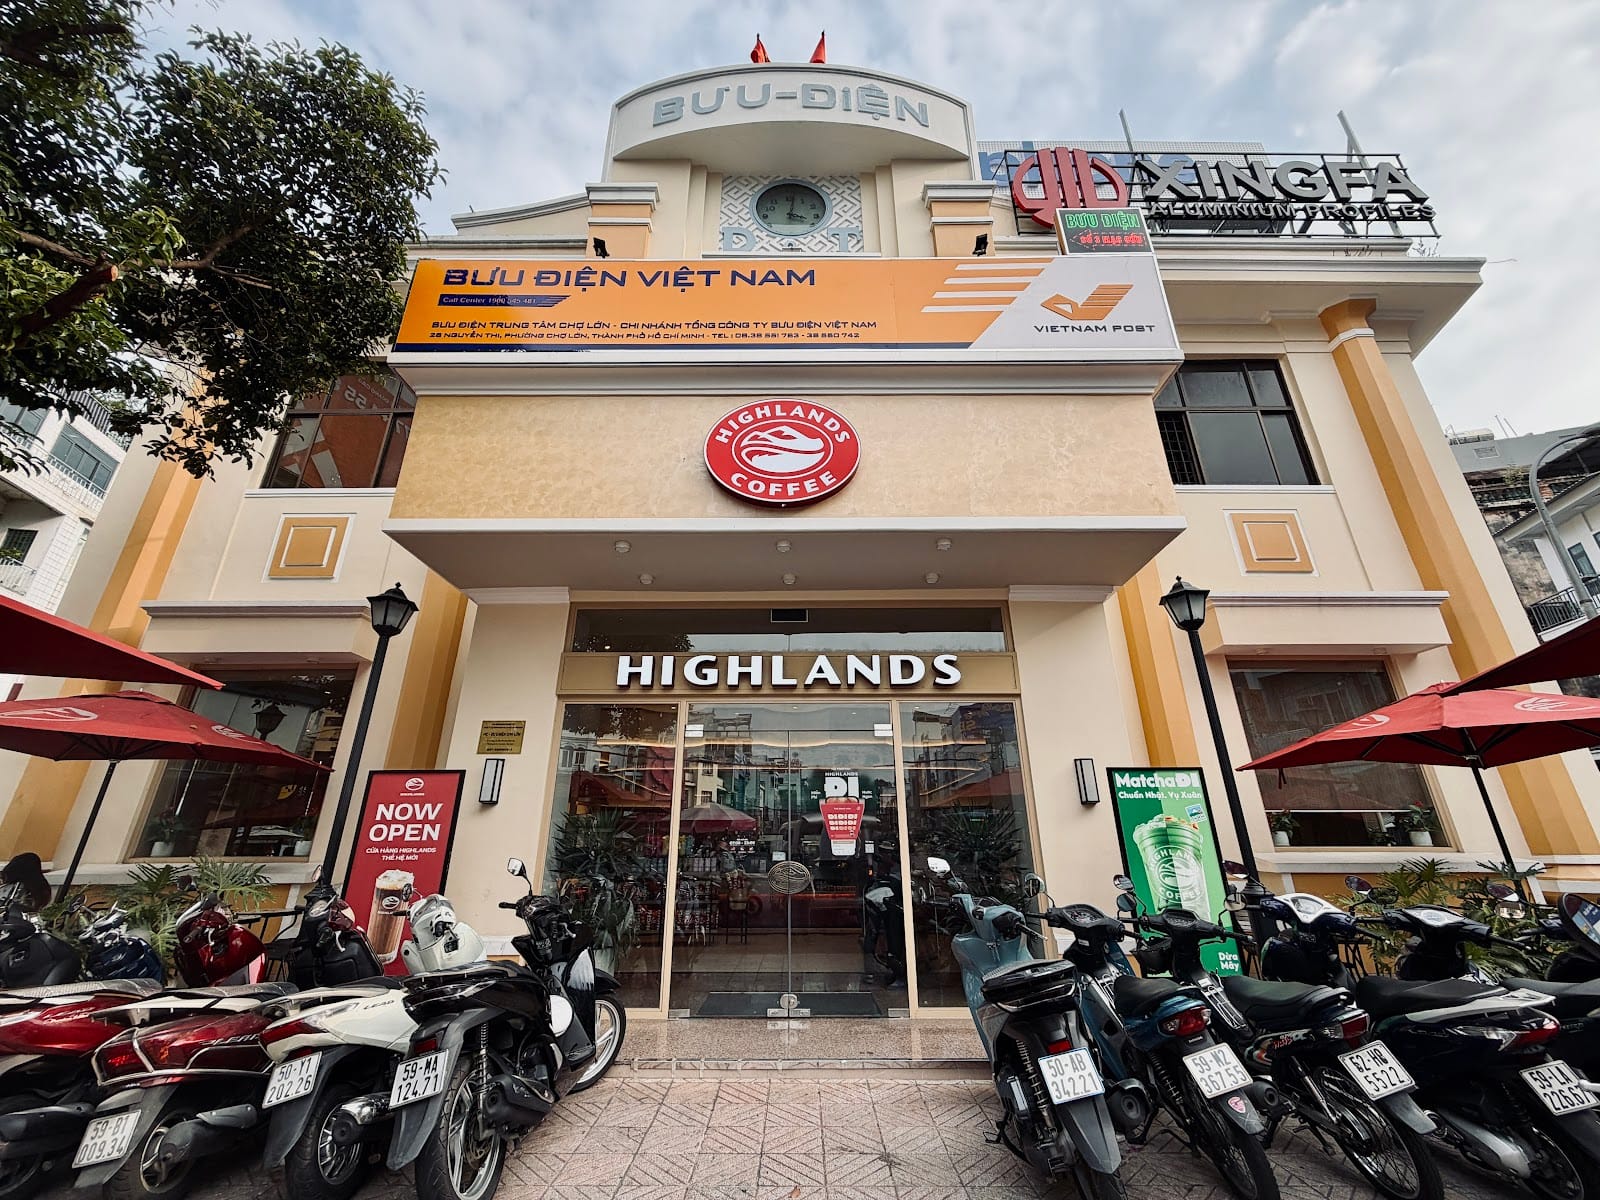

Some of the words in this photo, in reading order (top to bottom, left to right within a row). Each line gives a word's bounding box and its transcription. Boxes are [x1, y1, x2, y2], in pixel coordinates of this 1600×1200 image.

[1136, 160, 1429, 203] XINGFA
[1150, 204, 1297, 219] ALUMINIUM
[1305, 204, 1437, 219] PROFILES
[443, 266, 525, 286] BƯU
[533, 266, 628, 293] ĐIỆN
[637, 266, 721, 293] VIỆT
[730, 269, 816, 287] NAM
[460, 296, 486, 304] Center
[432, 321, 456, 329] BƯU
[458, 320, 487, 331] ĐIỆN
[489, 321, 530, 329] TRUNG
[532, 320, 556, 329] TÂM
[559, 321, 584, 331] CHỢ
[587, 320, 611, 329] LỚN
[641, 320, 682, 329] NHÁNH
[684, 319, 716, 329] TỔNG
[718, 320, 750, 329] CÔNG
[771, 320, 794, 329] BƯU
[796, 320, 822, 330] ĐIỆN
[824, 319, 849, 330] VIỆT
[851, 321, 877, 329] NAM
[591, 331, 624, 339] THÀNH
[626, 331, 646, 339] PHỐ
[647, 331, 662, 339] HỒ
[663, 331, 679, 339] CHÍ
[1033, 324, 1107, 333] VIETNAM
[1113, 324, 1156, 333] POST
[715, 404, 850, 444] HIGHLANDS
[730, 470, 837, 496] COFFEE
[616, 654, 962, 688] HIGHLANDS
[375, 803, 444, 821] NOW
[369, 823, 441, 842] OPEN
[1218, 951, 1239, 961] Dừa
[1220, 960, 1240, 972] Mây
[277, 1057, 313, 1082] 50-Y1
[402, 1055, 439, 1081] 59-MA
[1046, 1053, 1087, 1078] 50-AB
[1191, 1049, 1232, 1074] 59-N2
[266, 1074, 313, 1104] 202.26
[397, 1073, 439, 1103] 124.71
[1051, 1071, 1098, 1100] 342.21
[1199, 1064, 1247, 1094] 367.55
[1363, 1066, 1405, 1092] 5522
[1528, 1066, 1573, 1090] 59-LA
[1542, 1085, 1591, 1111] 226.67
[90, 1115, 130, 1140] 59-B1
[77, 1135, 126, 1163] 009.34
